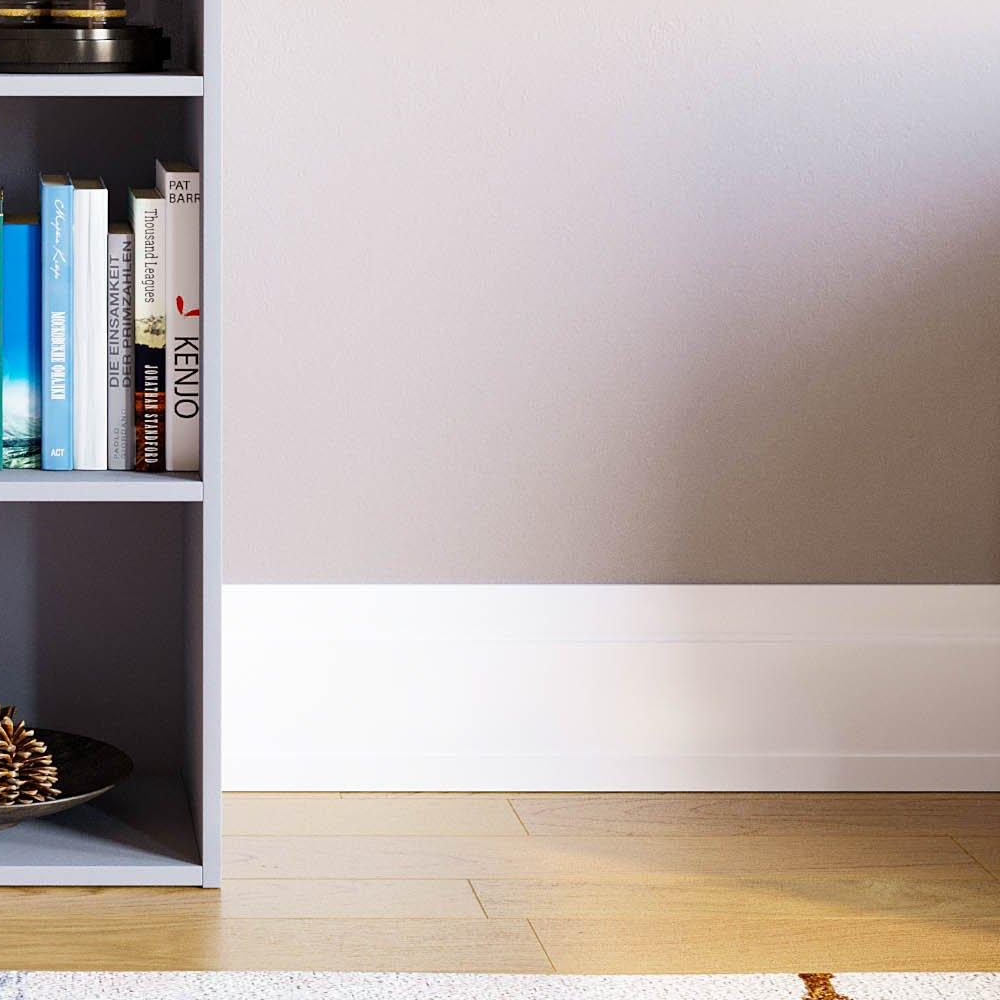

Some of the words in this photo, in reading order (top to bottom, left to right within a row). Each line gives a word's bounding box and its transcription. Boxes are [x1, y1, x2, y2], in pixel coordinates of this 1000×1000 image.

[169, 181, 190, 189] PAT
[144, 209, 158, 258] Thousand
[110, 255, 119, 354] EINSAMKEIT
[122, 241, 132, 353] PRIMZAHLEN
[142, 261, 158, 303] Leagues
[50, 312, 65, 362] МОСКОВСКИЕ
[50, 365, 65, 400] ФИАЛКИ
[110, 358, 119, 388] DIE
[122, 357, 132, 388] DER
[145, 365, 158, 409] JONATHAN
[174, 337, 199, 418] KENJO
[145, 413, 158, 463] STANDFORD
